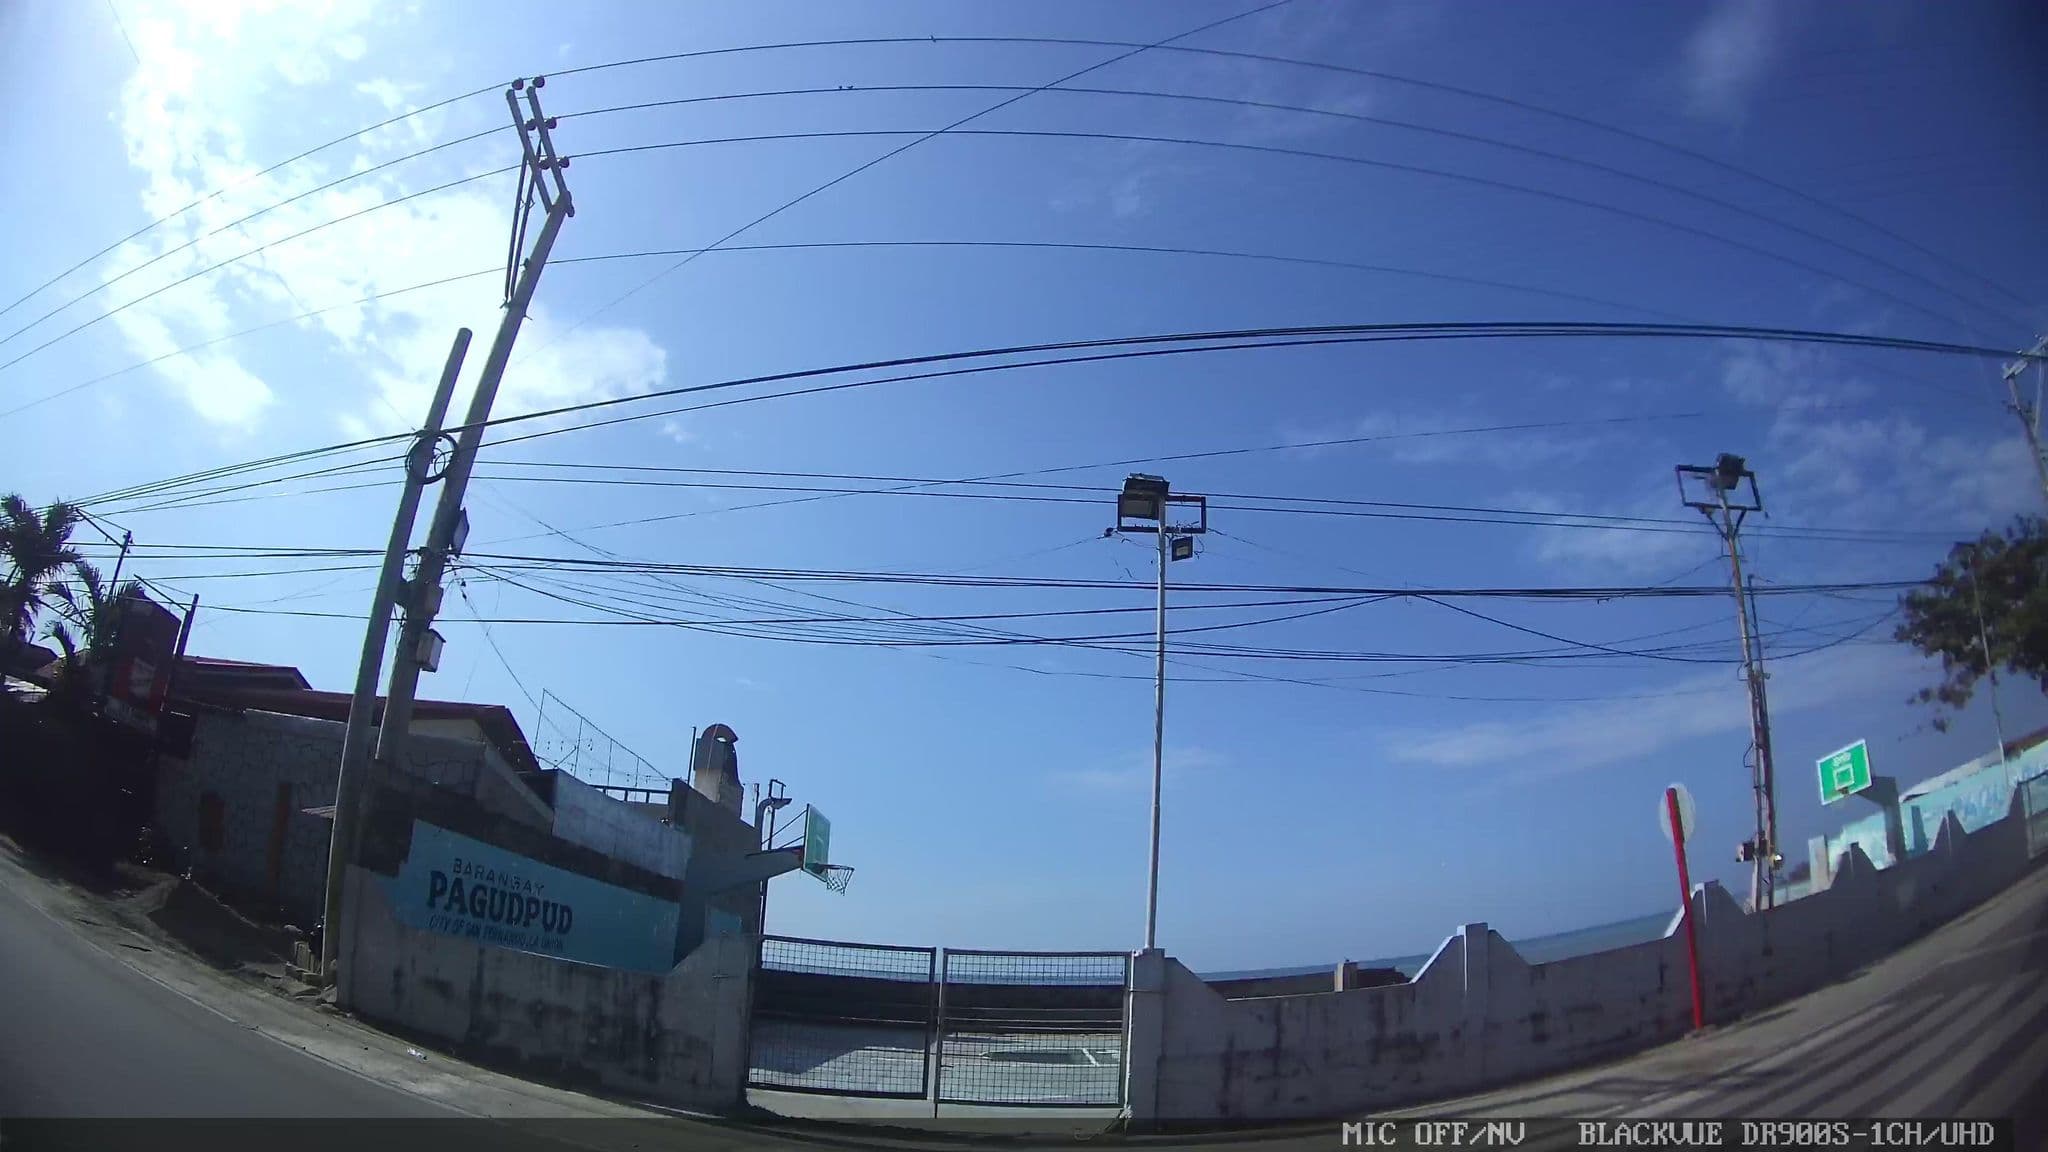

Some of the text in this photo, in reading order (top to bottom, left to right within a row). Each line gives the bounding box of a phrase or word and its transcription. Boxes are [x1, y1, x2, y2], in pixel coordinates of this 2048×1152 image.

[453, 858, 545, 896] BARANGAY
[427, 870, 573, 935] PAGUDPUD
[429, 914, 449, 934] CITY
